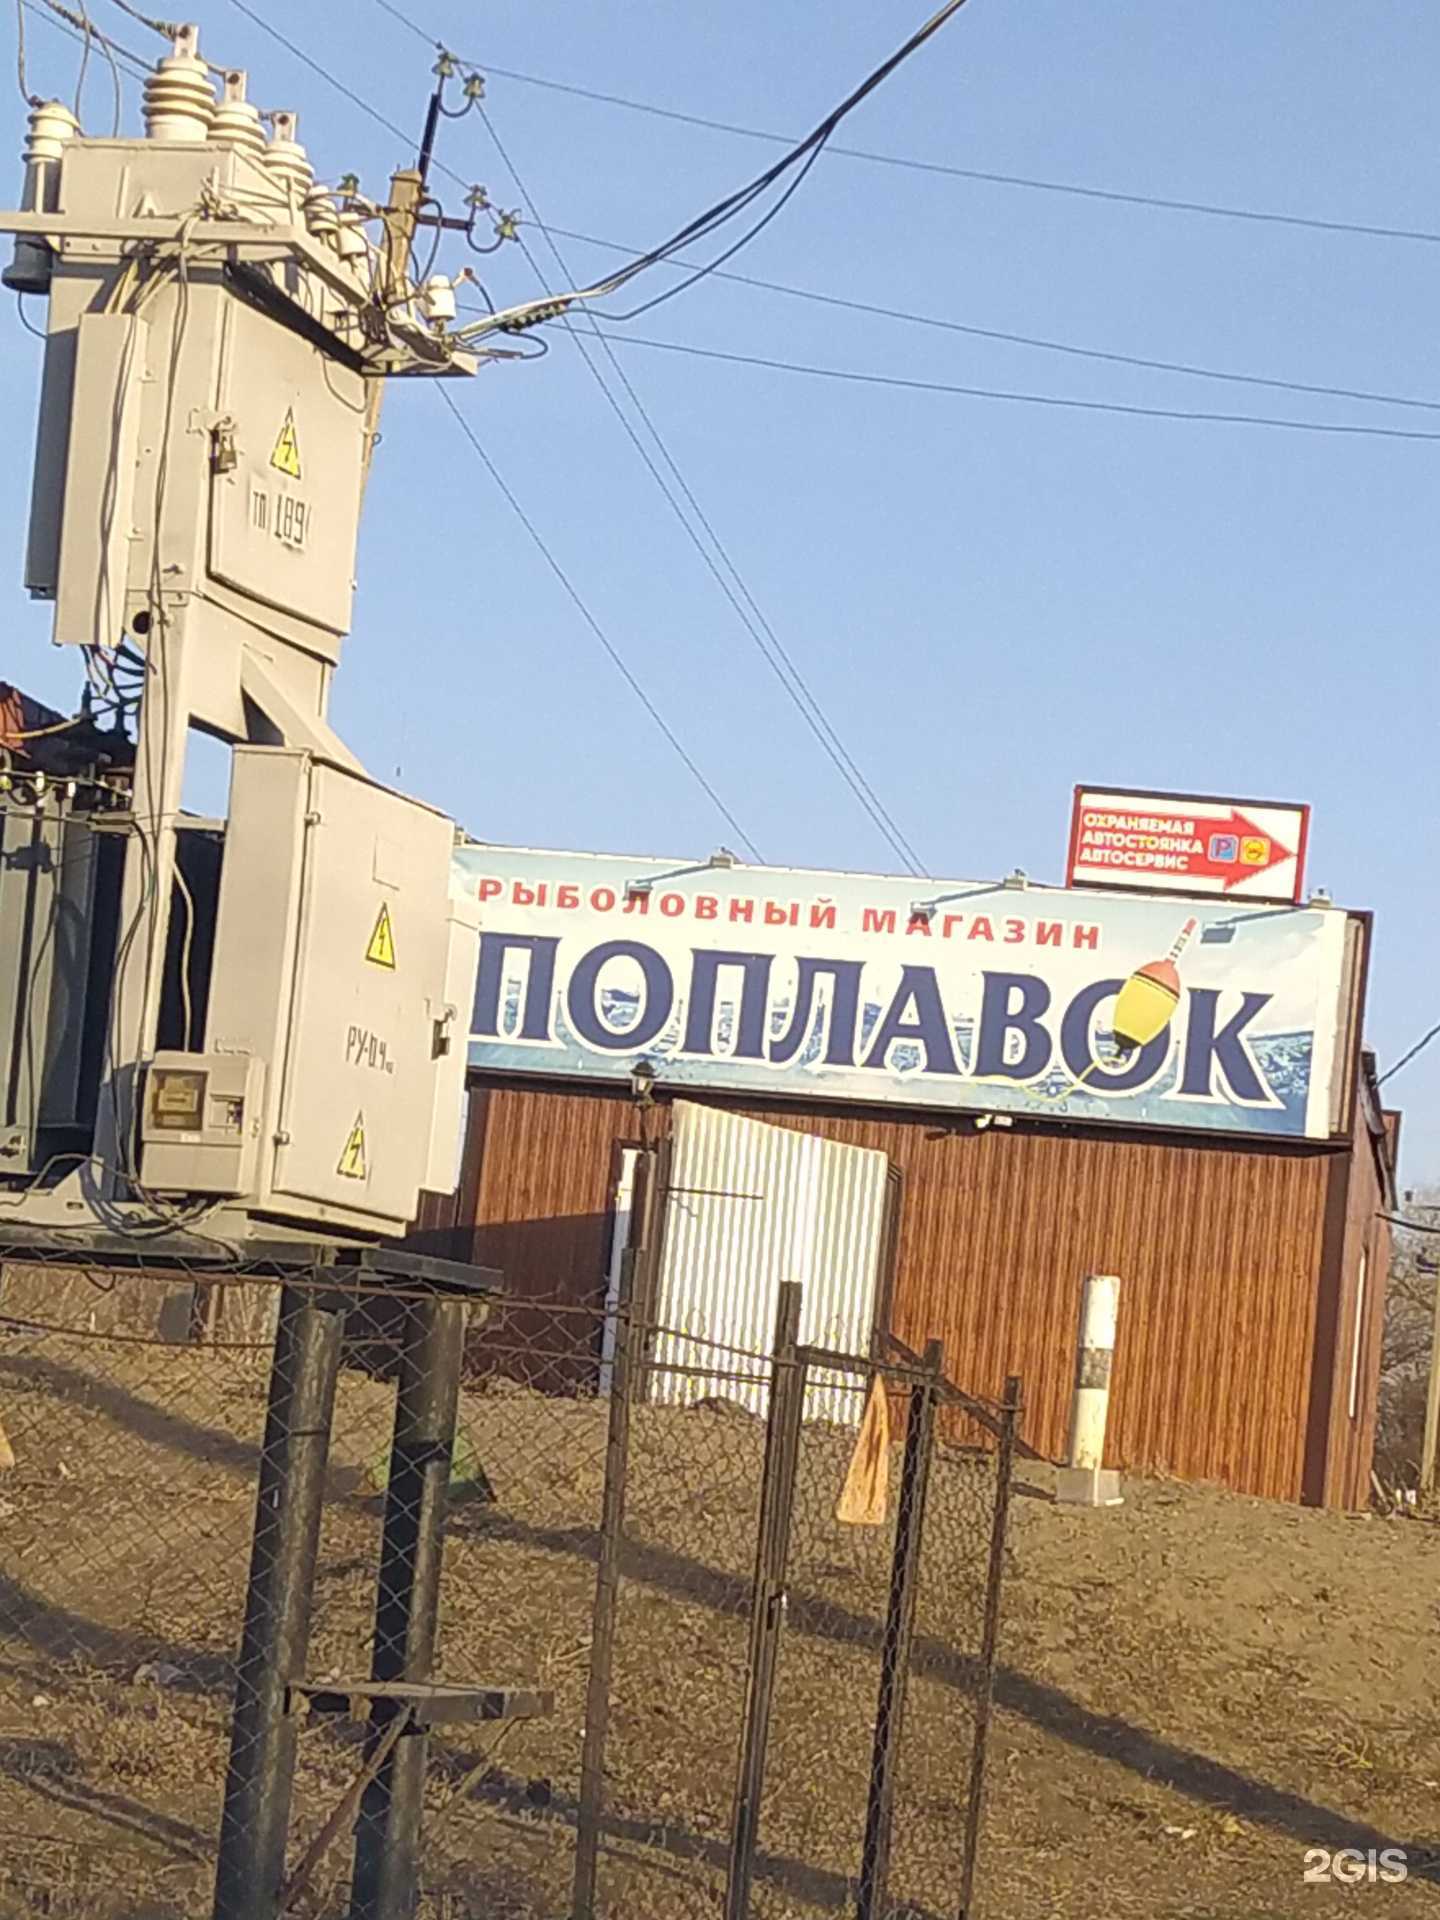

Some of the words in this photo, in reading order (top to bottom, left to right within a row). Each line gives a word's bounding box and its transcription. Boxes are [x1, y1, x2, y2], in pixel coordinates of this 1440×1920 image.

[1083, 812, 1195, 834] ОХРАНЯЕМАЯ
[1081, 830, 1203, 854] АВТОСТОЯНКА
[1079, 849, 1189, 870] АВТОСЕРВИС
[478, 878, 837, 930] РЫБОЛОВНЫЙ
[862, 908, 1100, 950] МАГАЗИН
[469, 930, 1275, 1102] ПОПЛАВОК
